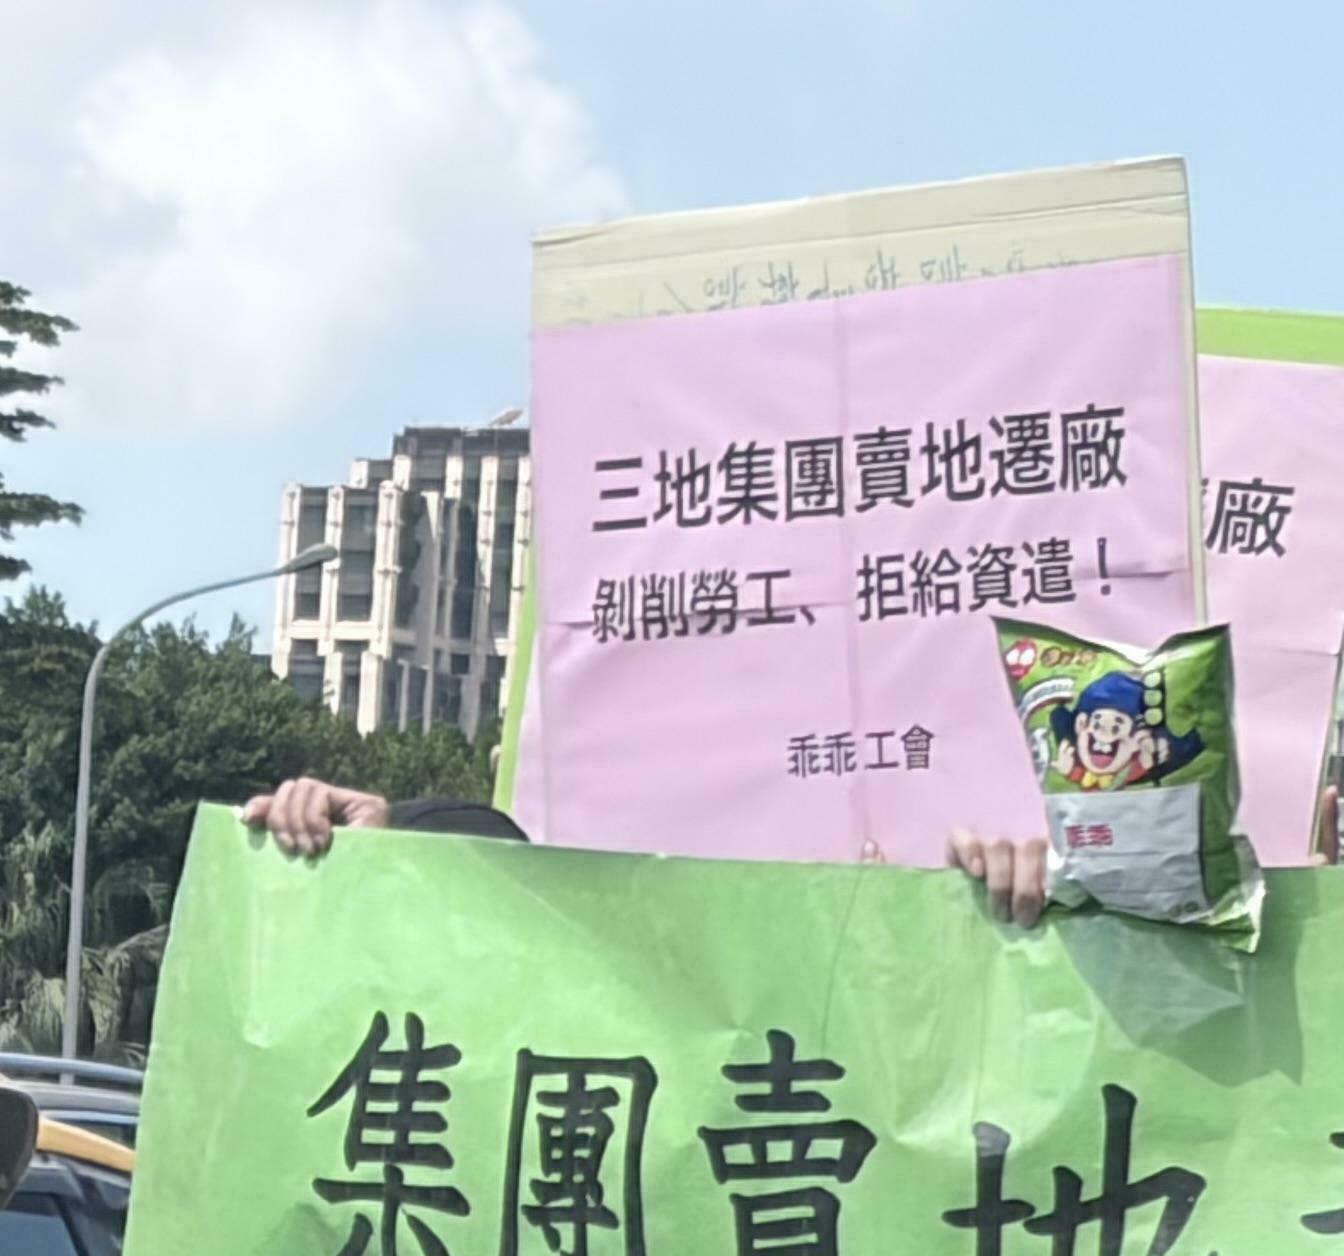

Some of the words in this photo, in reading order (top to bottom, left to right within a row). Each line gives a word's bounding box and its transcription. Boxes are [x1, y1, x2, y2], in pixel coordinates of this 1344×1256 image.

[592, 404, 1128, 533] 三地集團賣地遷廠
[787, 724, 935, 780] 乖乖工會
